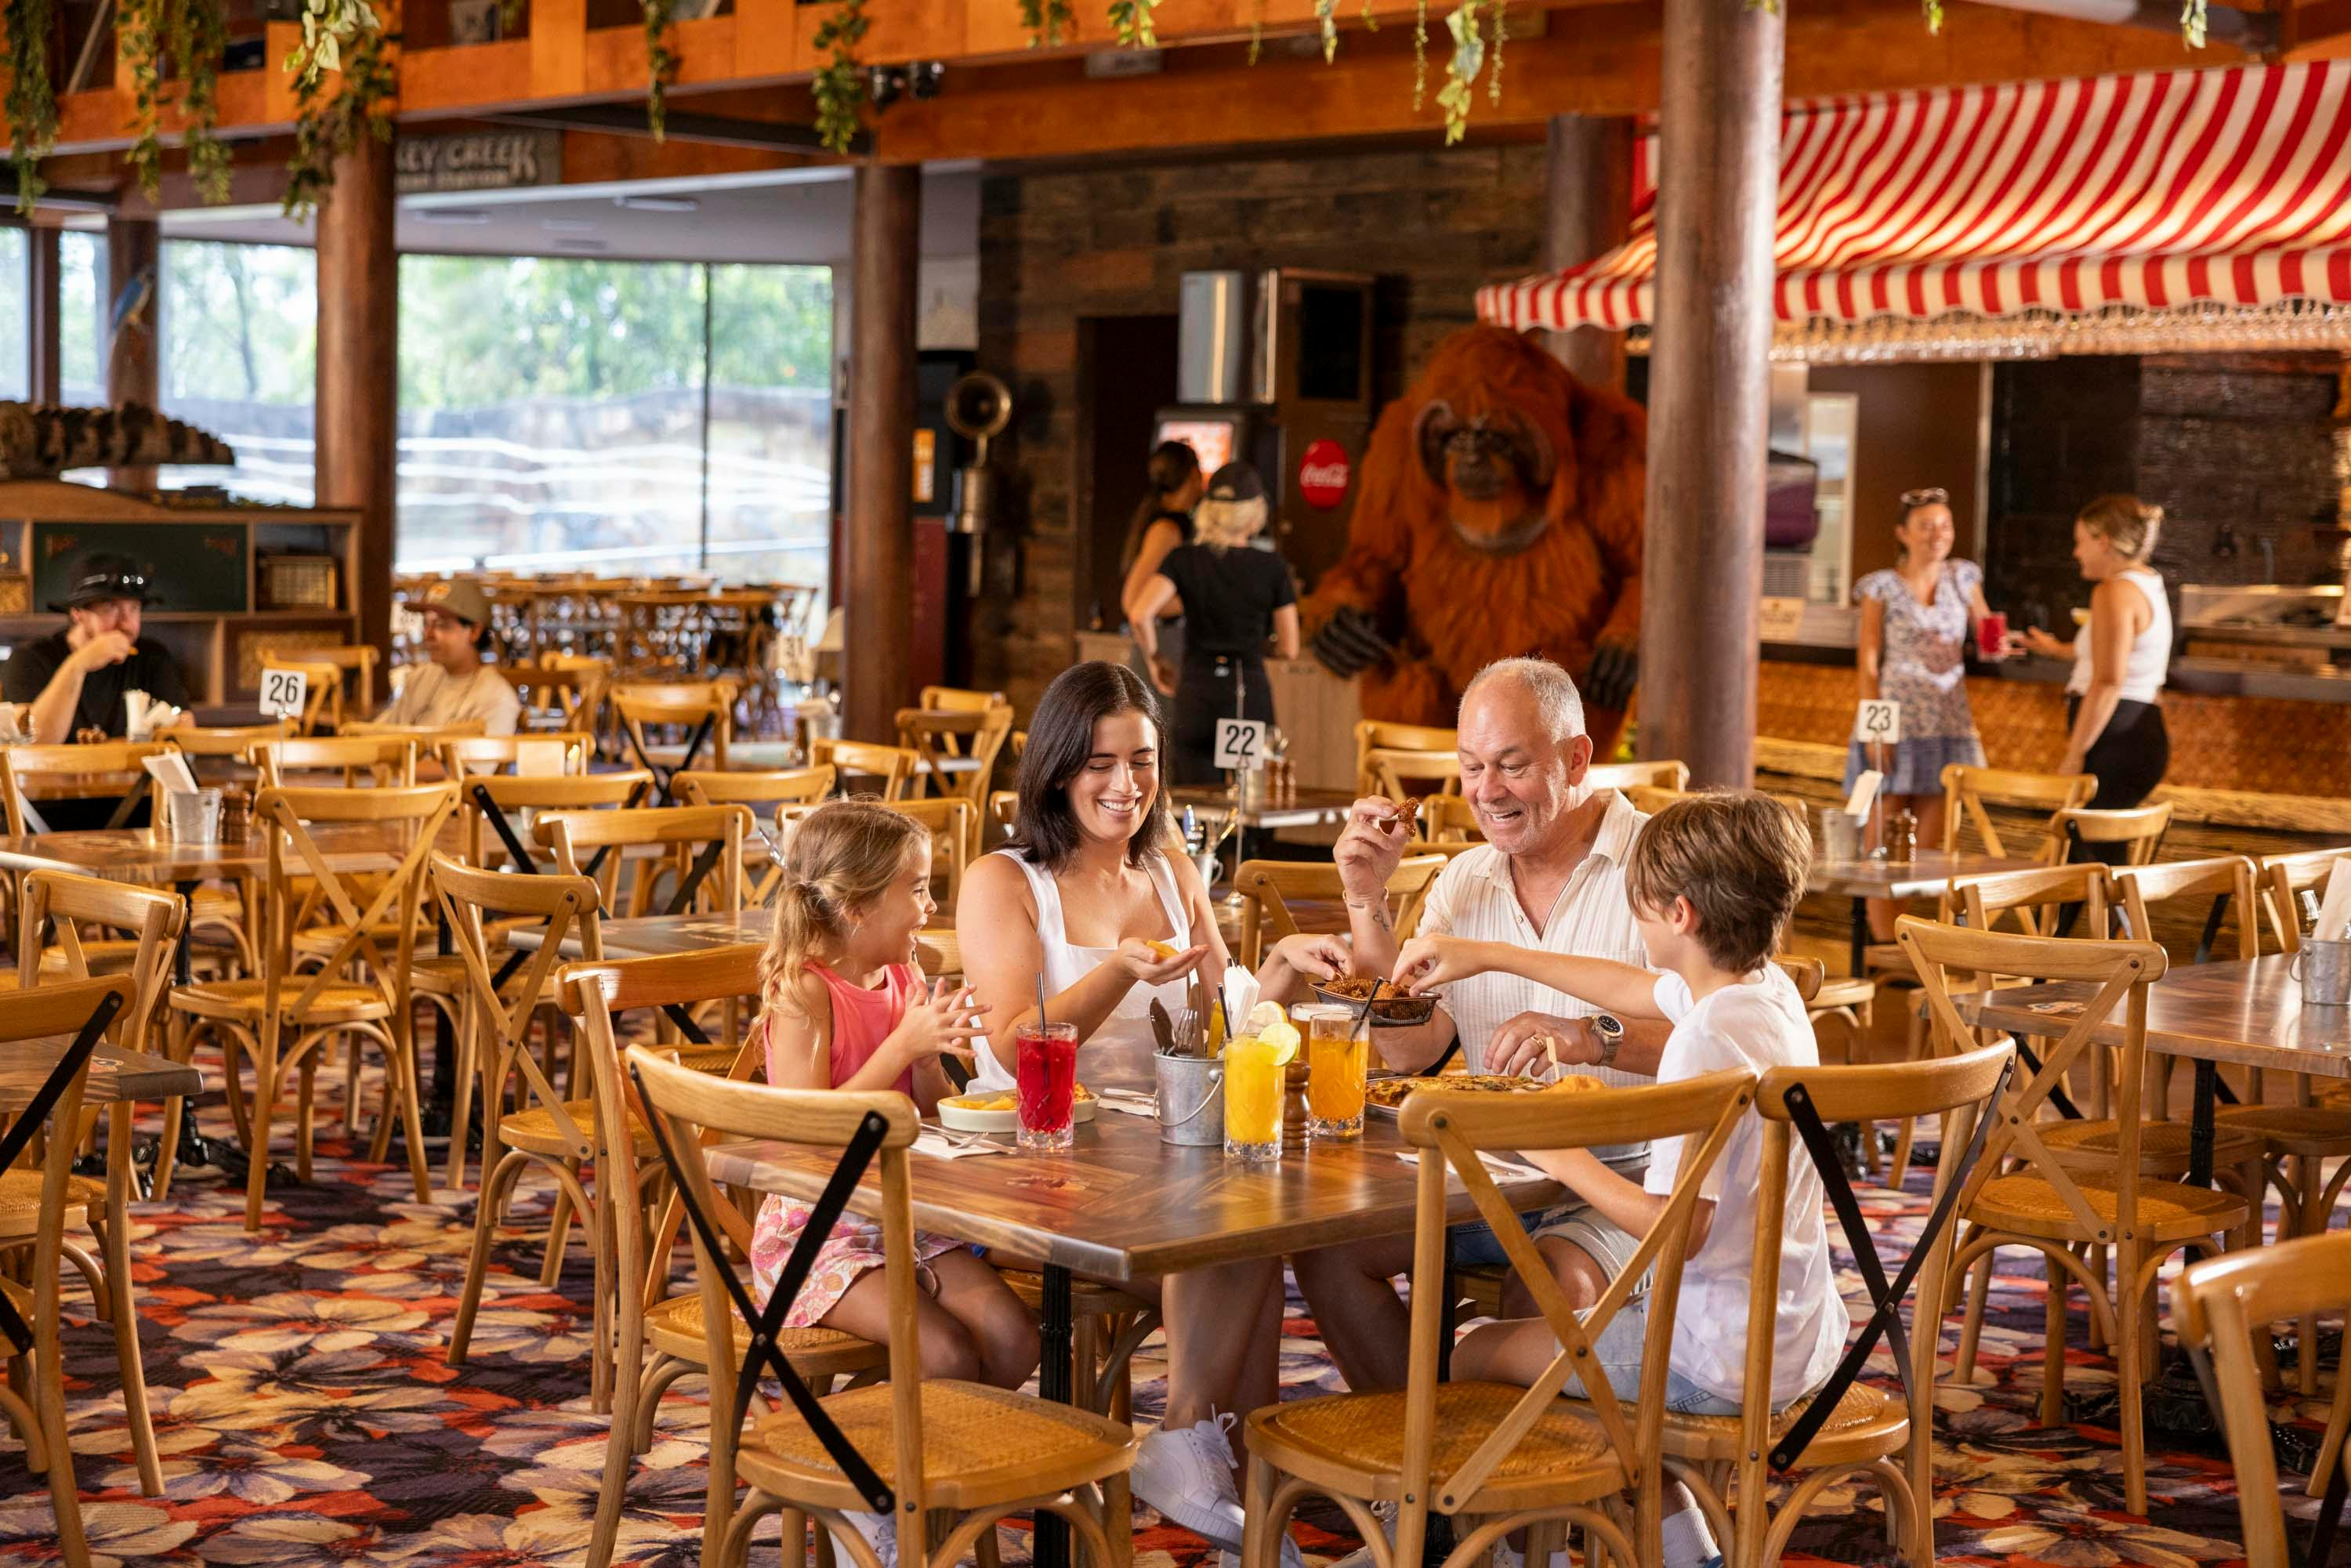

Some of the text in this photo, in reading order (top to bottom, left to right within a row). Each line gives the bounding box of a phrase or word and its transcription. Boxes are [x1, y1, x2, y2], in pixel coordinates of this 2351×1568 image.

[447, 136, 538, 179] CREEK
[270, 674, 298, 704] 26
[1867, 705, 1891, 733] 23
[1225, 725, 1255, 756] 22
